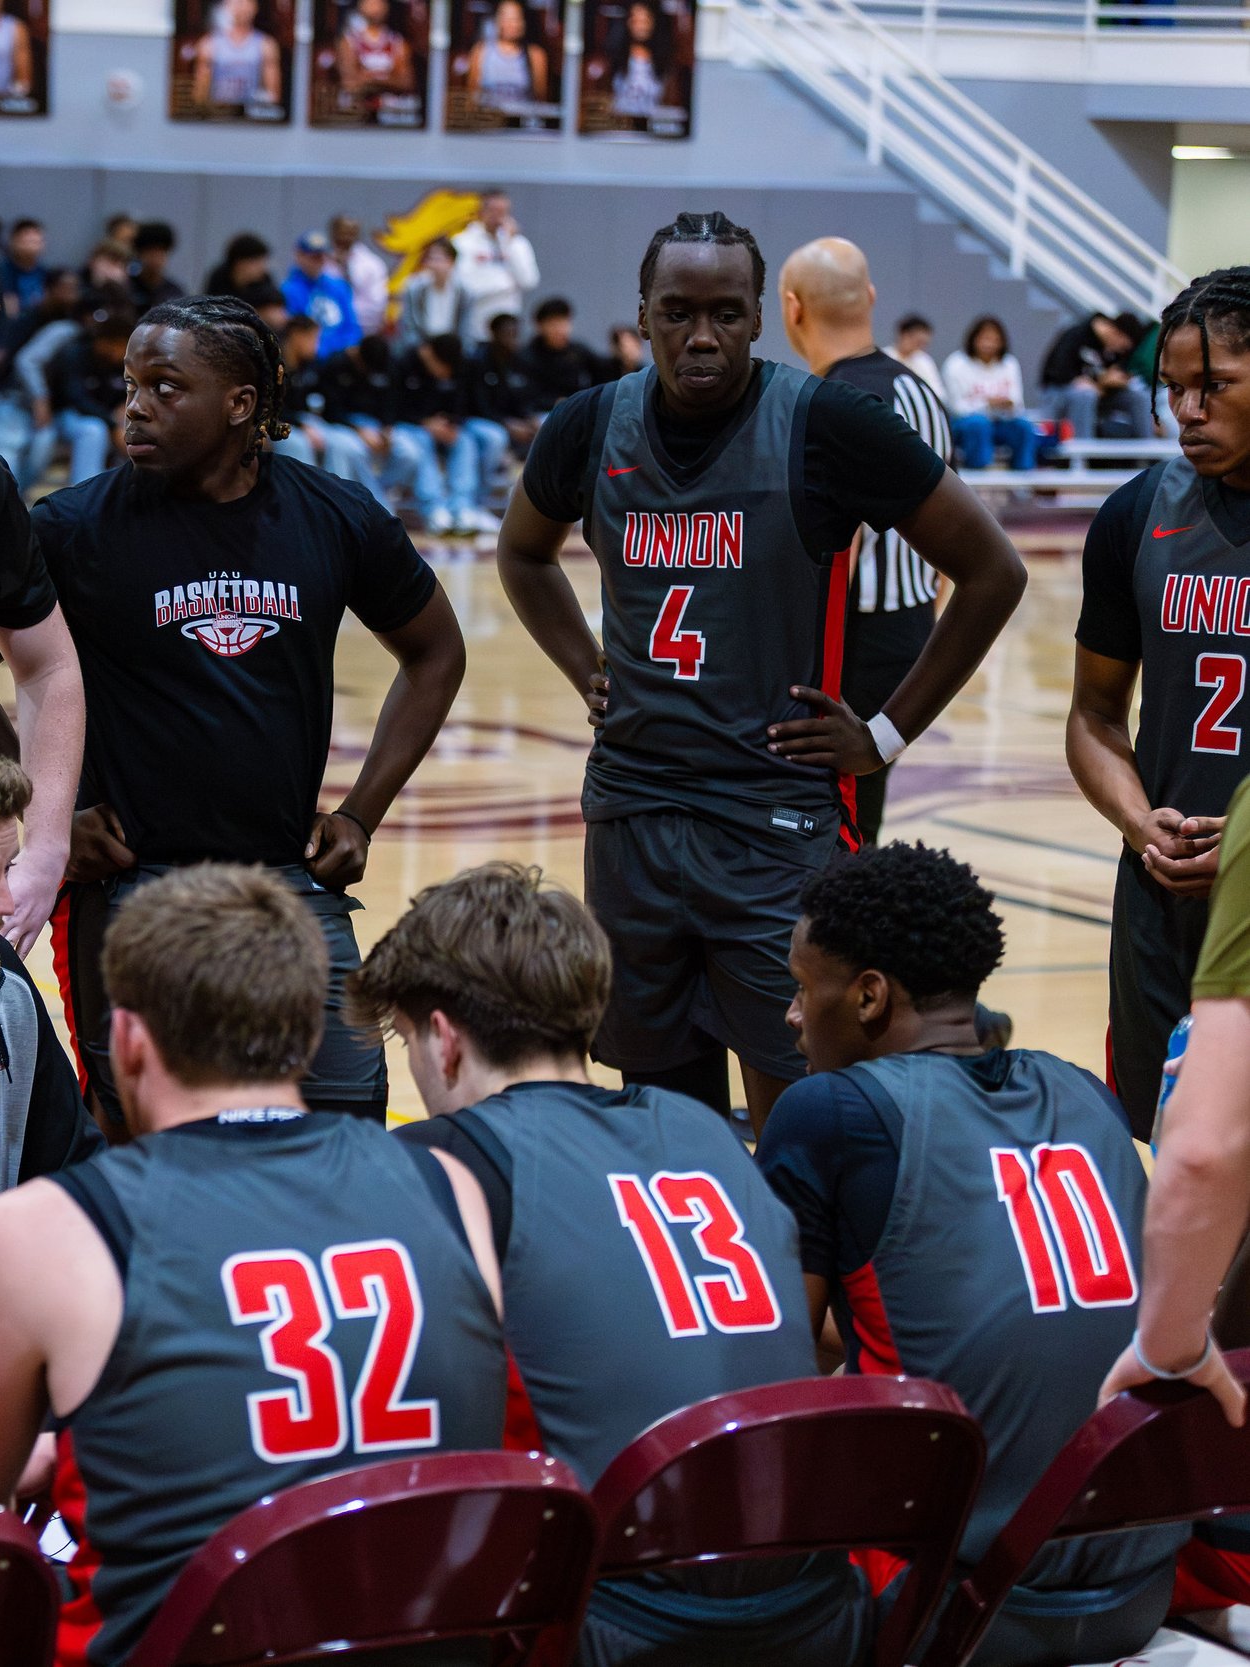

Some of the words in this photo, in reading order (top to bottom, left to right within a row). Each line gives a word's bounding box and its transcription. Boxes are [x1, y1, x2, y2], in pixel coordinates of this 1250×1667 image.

[209, 571, 241, 579] UAU
[623, 511, 743, 568] UNION
[154, 579, 302, 628] BASKETBALL
[650, 585, 706, 681] 4
[1191, 652, 1247, 756] 2
[804, 820, 814, 831] M
[606, 1170, 783, 1338] 13
[989, 1142, 1139, 1314] 10
[220, 1238, 440, 1464] 32
